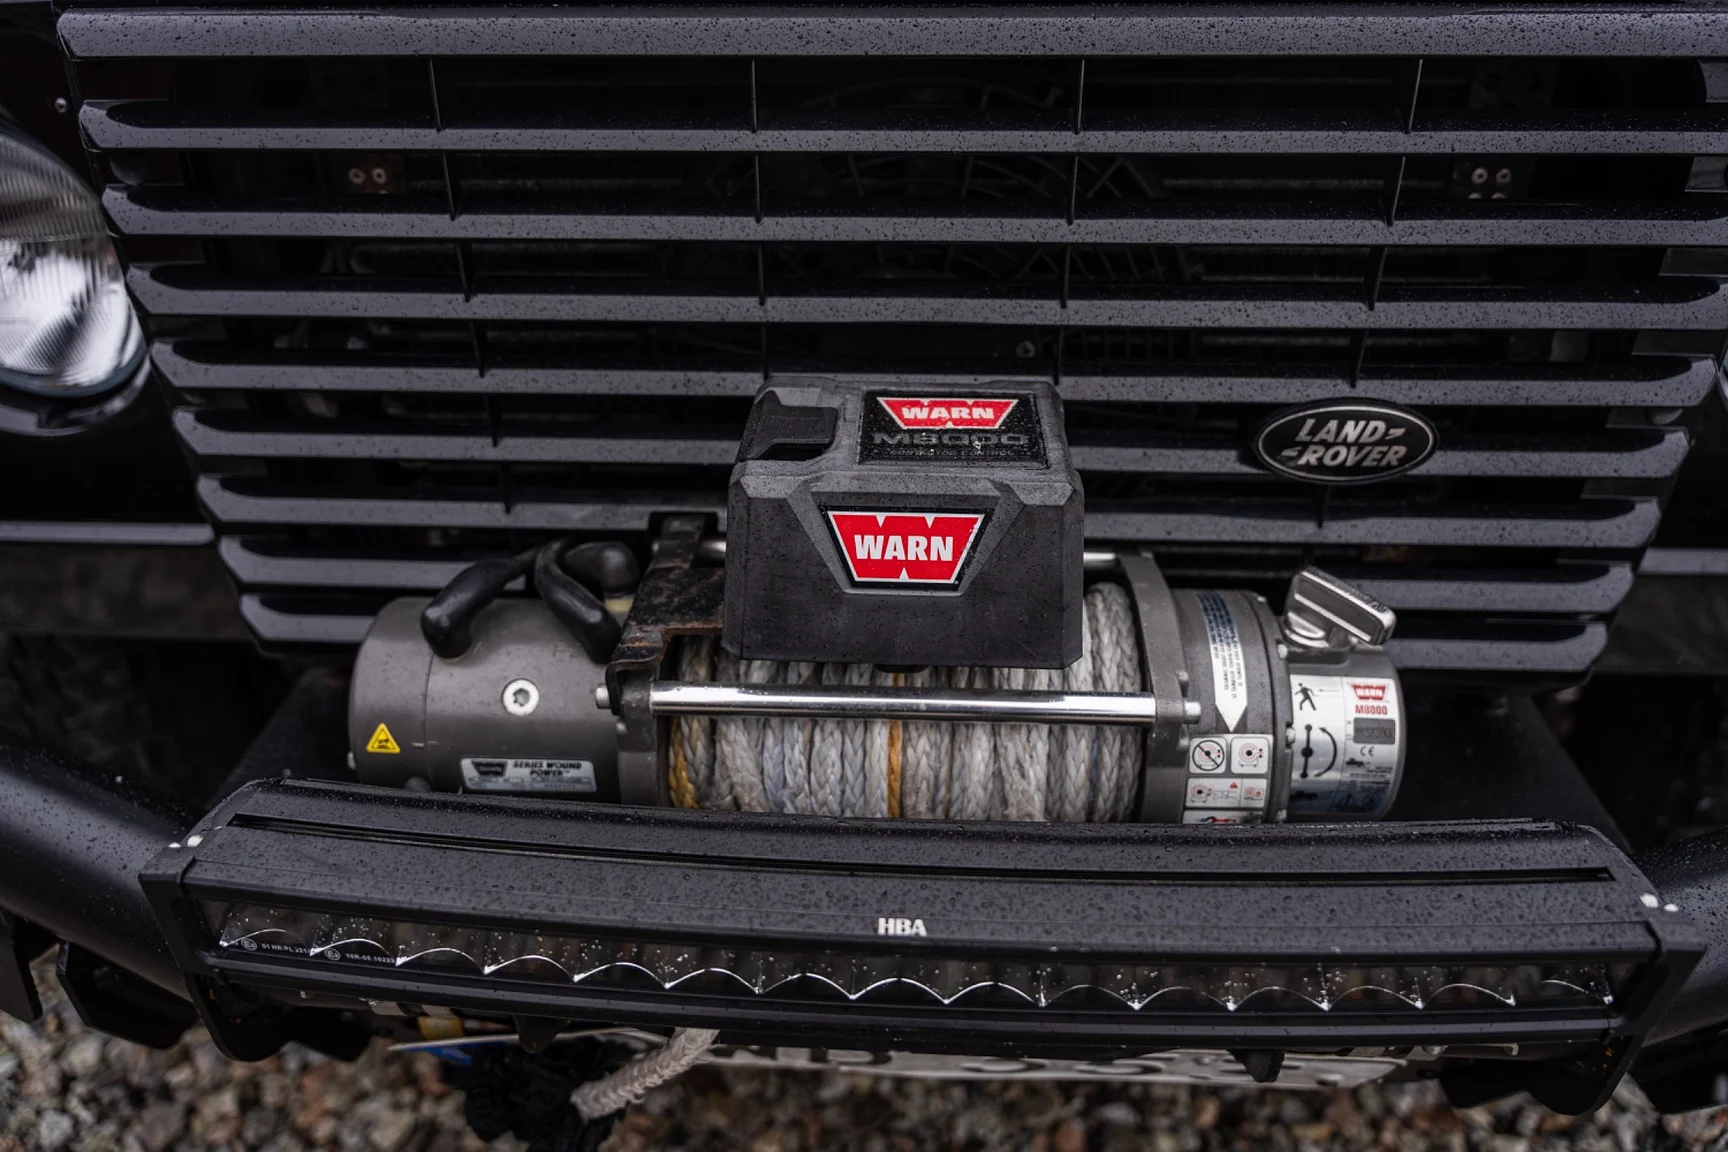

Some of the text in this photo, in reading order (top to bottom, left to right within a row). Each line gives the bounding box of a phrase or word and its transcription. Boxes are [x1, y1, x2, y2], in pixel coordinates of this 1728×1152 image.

[902, 407, 995, 419] WARN
[873, 432, 1030, 445] M8000
[1295, 418, 1386, 443] LAND
[1297, 445, 1408, 467] ROVER
[854, 534, 954, 561] WARN
[1355, 704, 1388, 715] M8000
[513, 761, 544, 769] SERIES
[878, 917, 928, 937] HBA
